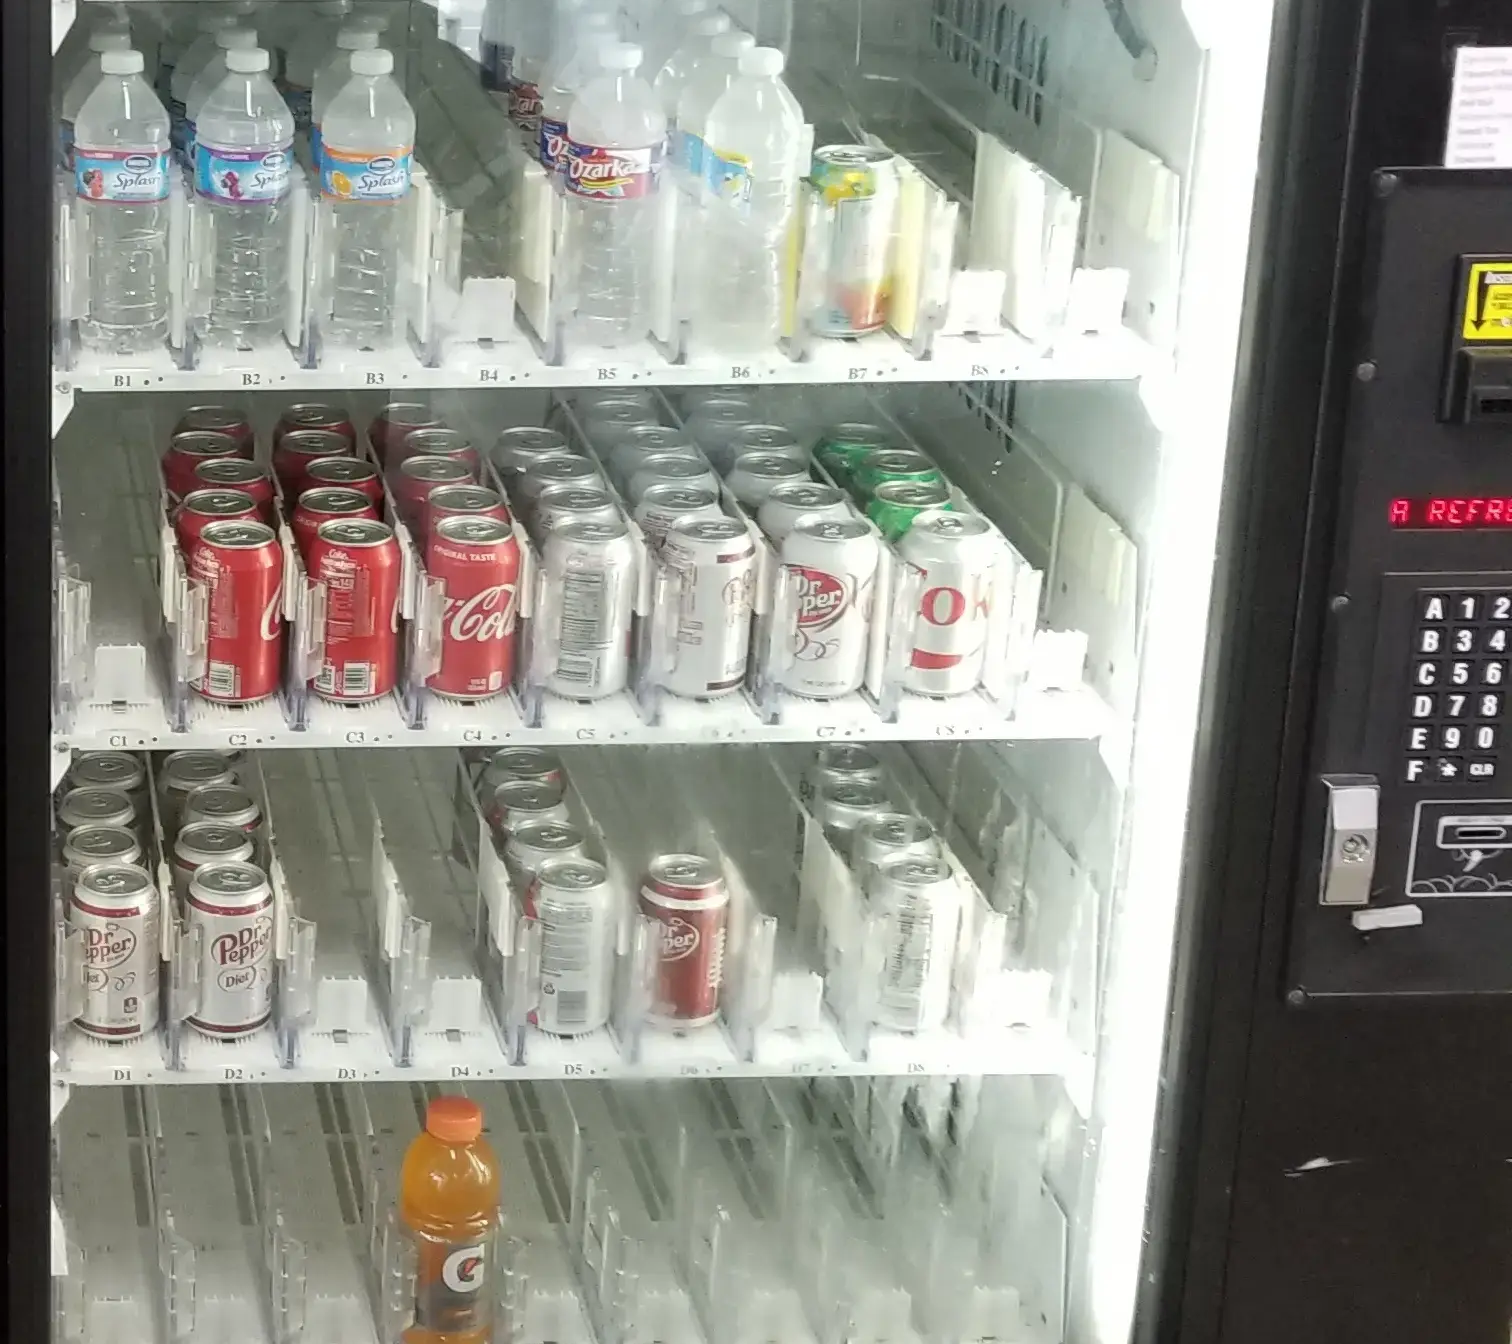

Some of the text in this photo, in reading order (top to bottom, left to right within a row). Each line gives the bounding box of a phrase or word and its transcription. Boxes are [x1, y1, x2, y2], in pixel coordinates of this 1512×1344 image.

[113, 375, 133, 388] B1
[242, 373, 261, 387] B2
[365, 372, 385, 385] B3
[479, 368, 499, 382] B4
[597, 367, 617, 381] B5
[731, 366, 751, 379] B6
[848, 366, 868, 380] B7
[1389, 499, 1410, 525] A
[469, 552, 497, 562] TASTE
[1424, 598, 1444, 621] A
[1460, 597, 1476, 619] 1
[1493, 597, 1511, 619] 2
[1422, 630, 1439, 653] B
[1456, 630, 1473, 652] 3
[1489, 630, 1506, 652] 4
[1418, 663, 1436, 686] C
[1451, 662, 1469, 685] 5
[1485, 662, 1502, 685] 6
[1414, 695, 1433, 718] D
[1448, 695, 1466, 717] 7
[1481, 694, 1498, 717] 8
[109, 735, 129, 748] C1
[228, 733, 248, 747] C2
[345, 731, 365, 744] C3
[462, 729, 482, 743] C4
[576, 728, 596, 740] C5
[1410, 727, 1428, 750] E
[1444, 726, 1461, 749] 9
[1478, 726, 1494, 749] 0
[1406, 759, 1424, 782] F
[89, 928, 114, 947] Dr
[238, 925, 262, 948] Dr
[224, 971, 250, 988] Diet
[113, 1068, 133, 1081] D1
[224, 1067, 244, 1080] D2
[337, 1067, 357, 1080] D3
[451, 1065, 470, 1077] D4
[564, 1063, 583, 1076] D5
[441, 1243, 485, 1293] G
